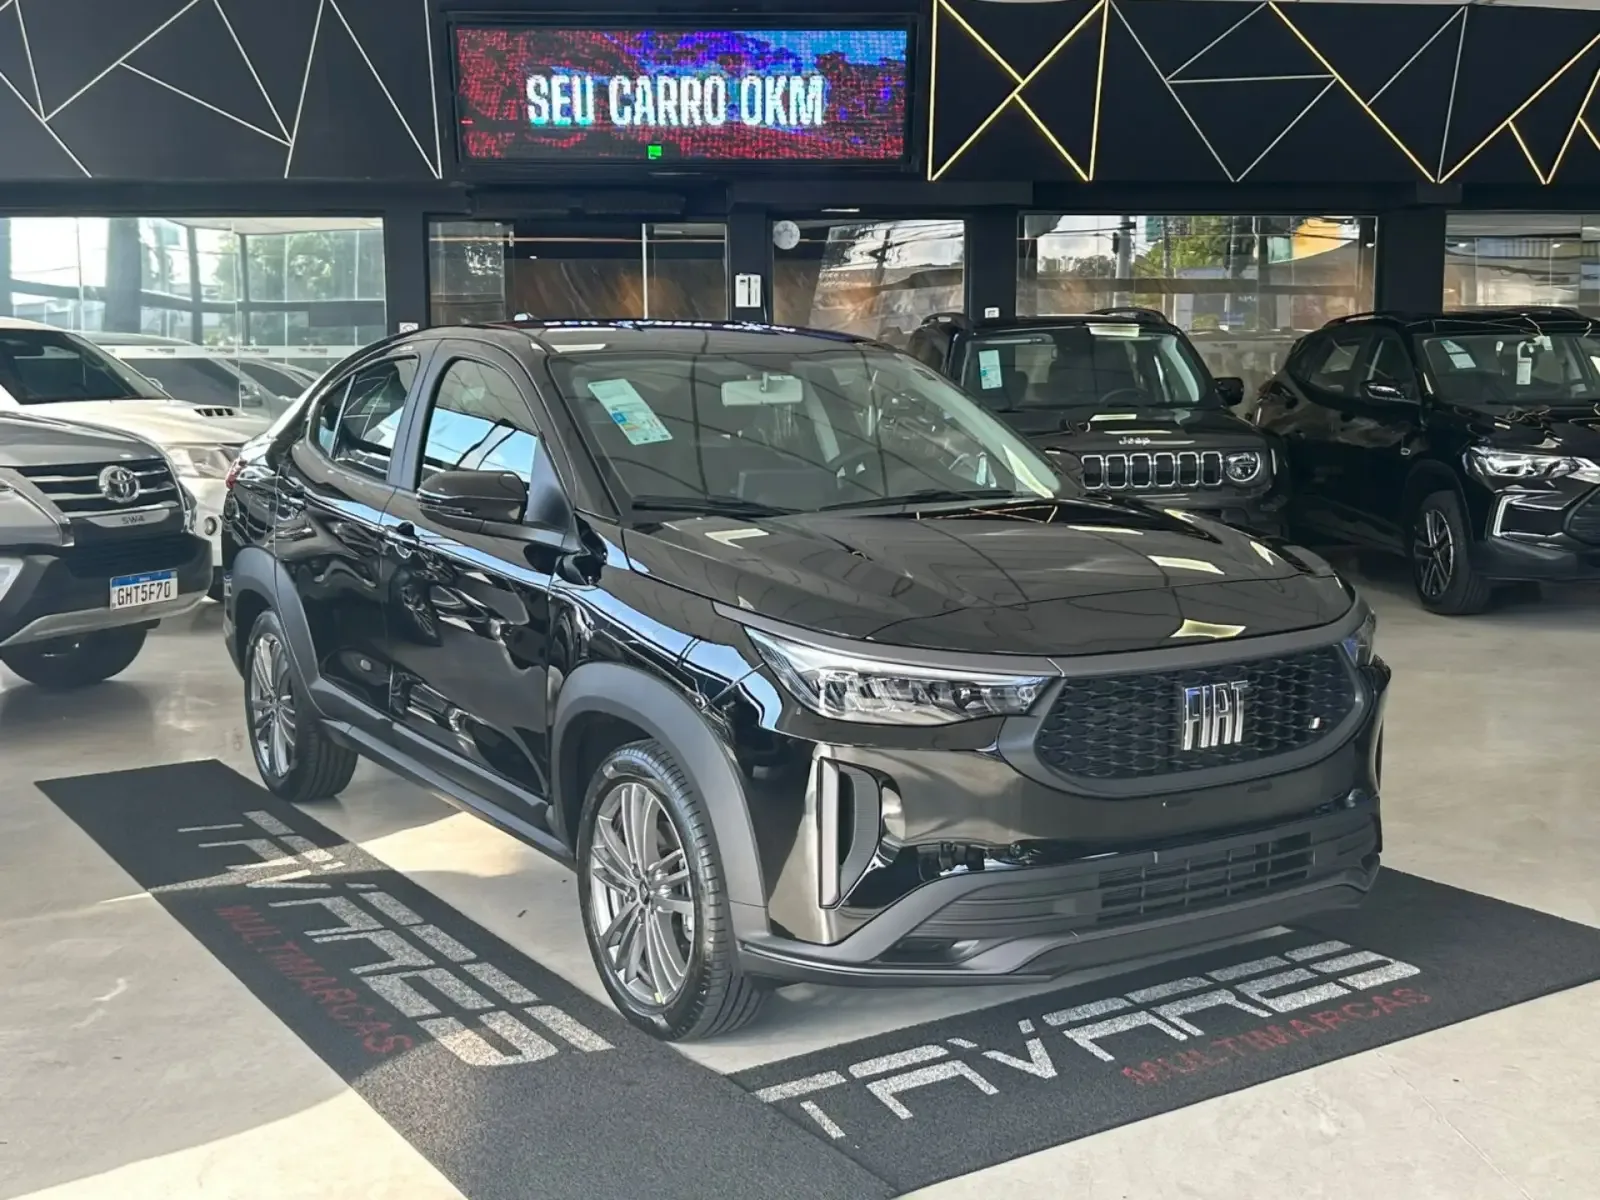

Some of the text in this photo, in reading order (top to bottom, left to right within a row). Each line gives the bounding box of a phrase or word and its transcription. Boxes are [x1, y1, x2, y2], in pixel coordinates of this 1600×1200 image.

[526, 75, 594, 125] SEU
[608, 75, 726, 125] CARRO
[121, 515, 145, 525] SW4
[117, 581, 171, 606] GHT5F70
[1183, 680, 1249, 750] FIAT
[178, 810, 616, 1066] TAVARES
[756, 941, 1421, 1138] TAVARES
[1121, 987, 1431, 1087] MULTIMARCAS
